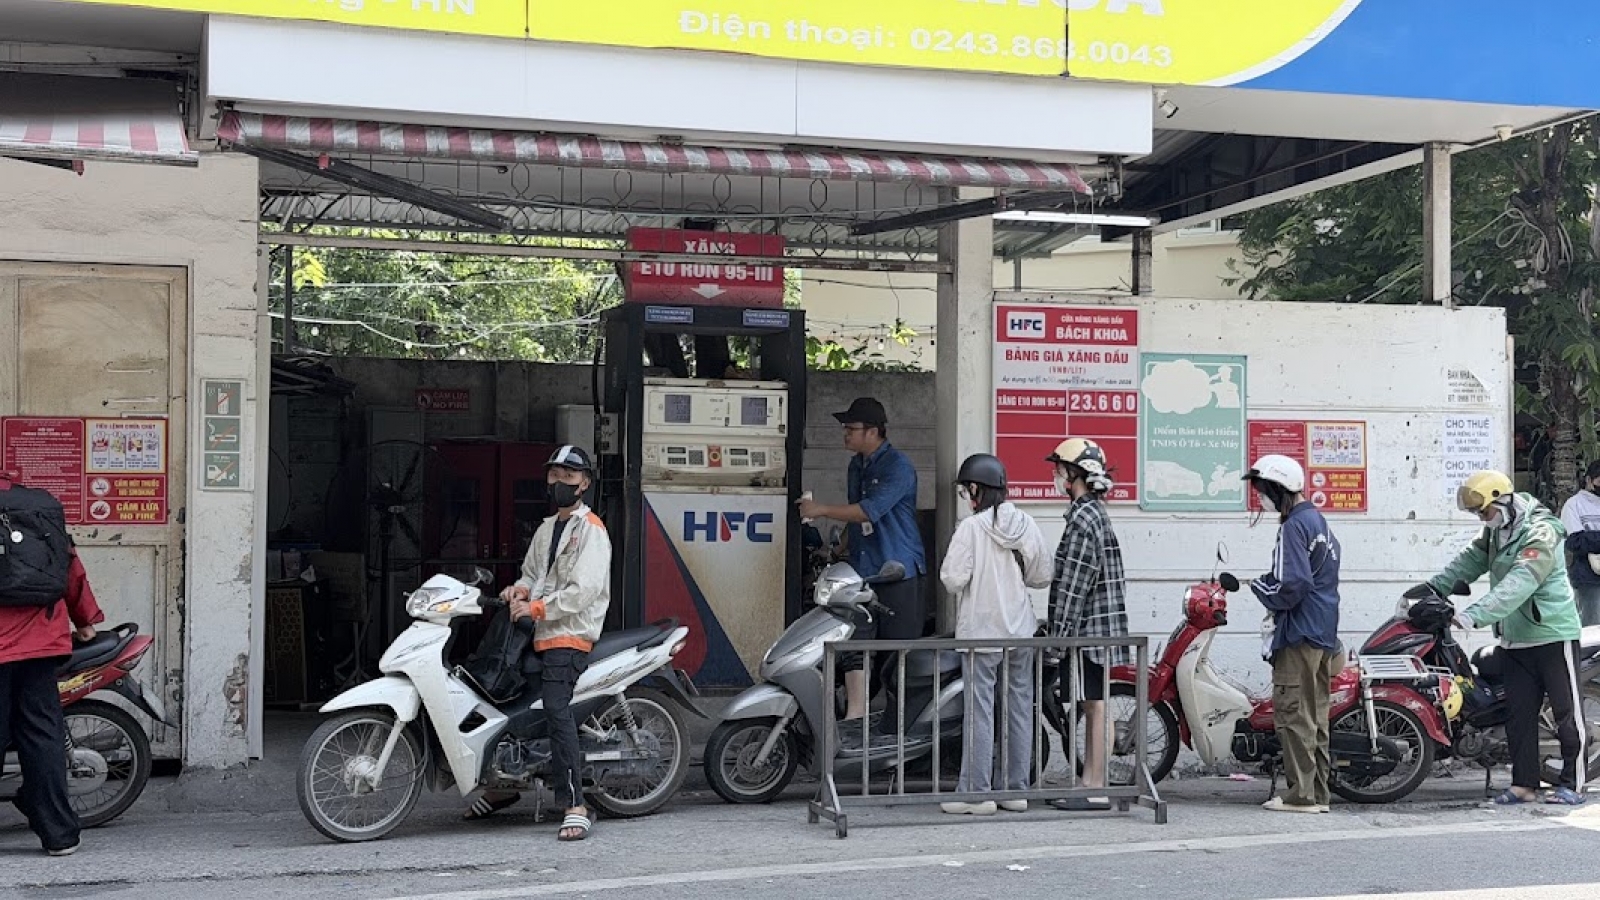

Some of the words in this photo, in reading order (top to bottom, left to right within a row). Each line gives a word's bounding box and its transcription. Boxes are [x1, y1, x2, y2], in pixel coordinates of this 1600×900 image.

[679, 10, 771, 41] Điện
[785, 19, 895, 51] thoại:
[909, 28, 1172, 67] 0243.868.0043
[684, 238, 736, 254] XĂNG
[641, 262, 675, 276] E10
[680, 263, 720, 280] RON
[725, 265, 774, 282] 95-III
[1010, 318, 1042, 331] HFC
[1061, 313, 1074, 323] CỬA
[1075, 313, 1092, 323] HÀNG
[1092, 314, 1110, 324] XĂNG
[1110, 314, 1124, 324] DẦU
[1056, 324, 1091, 340] BÁCH
[1093, 328, 1128, 340] KHOA
[1005, 346, 1039, 361] BẢNG
[1043, 347, 1064, 362] GIÁ
[1067, 349, 1100, 363] XĂNG
[1104, 350, 1129, 364] DẦU
[1070, 393, 1136, 412] 23.660
[1445, 419, 1465, 429] CHO
[1466, 417, 1490, 429] THUÊ
[1208, 440, 1220, 448] Xe
[1221, 439, 1240, 450] Máy
[1445, 460, 1465, 470] CHO
[1466, 459, 1490, 470] THUÊ
[114, 478, 128, 487] CẤM
[128, 478, 141, 487] HÚT
[141, 478, 160, 487] THUỐC
[118, 488, 127, 496] NO
[129, 488, 156, 496] SMOKING
[1007, 486, 1022, 498] HỜI
[1023, 487, 1043, 498] GIAN
[1330, 492, 1347, 501] CẤM
[1348, 492, 1362, 501] LỬA
[116, 500, 139, 511] CẤM
[140, 500, 159, 511] LỬA
[683, 511, 774, 543] HFC
